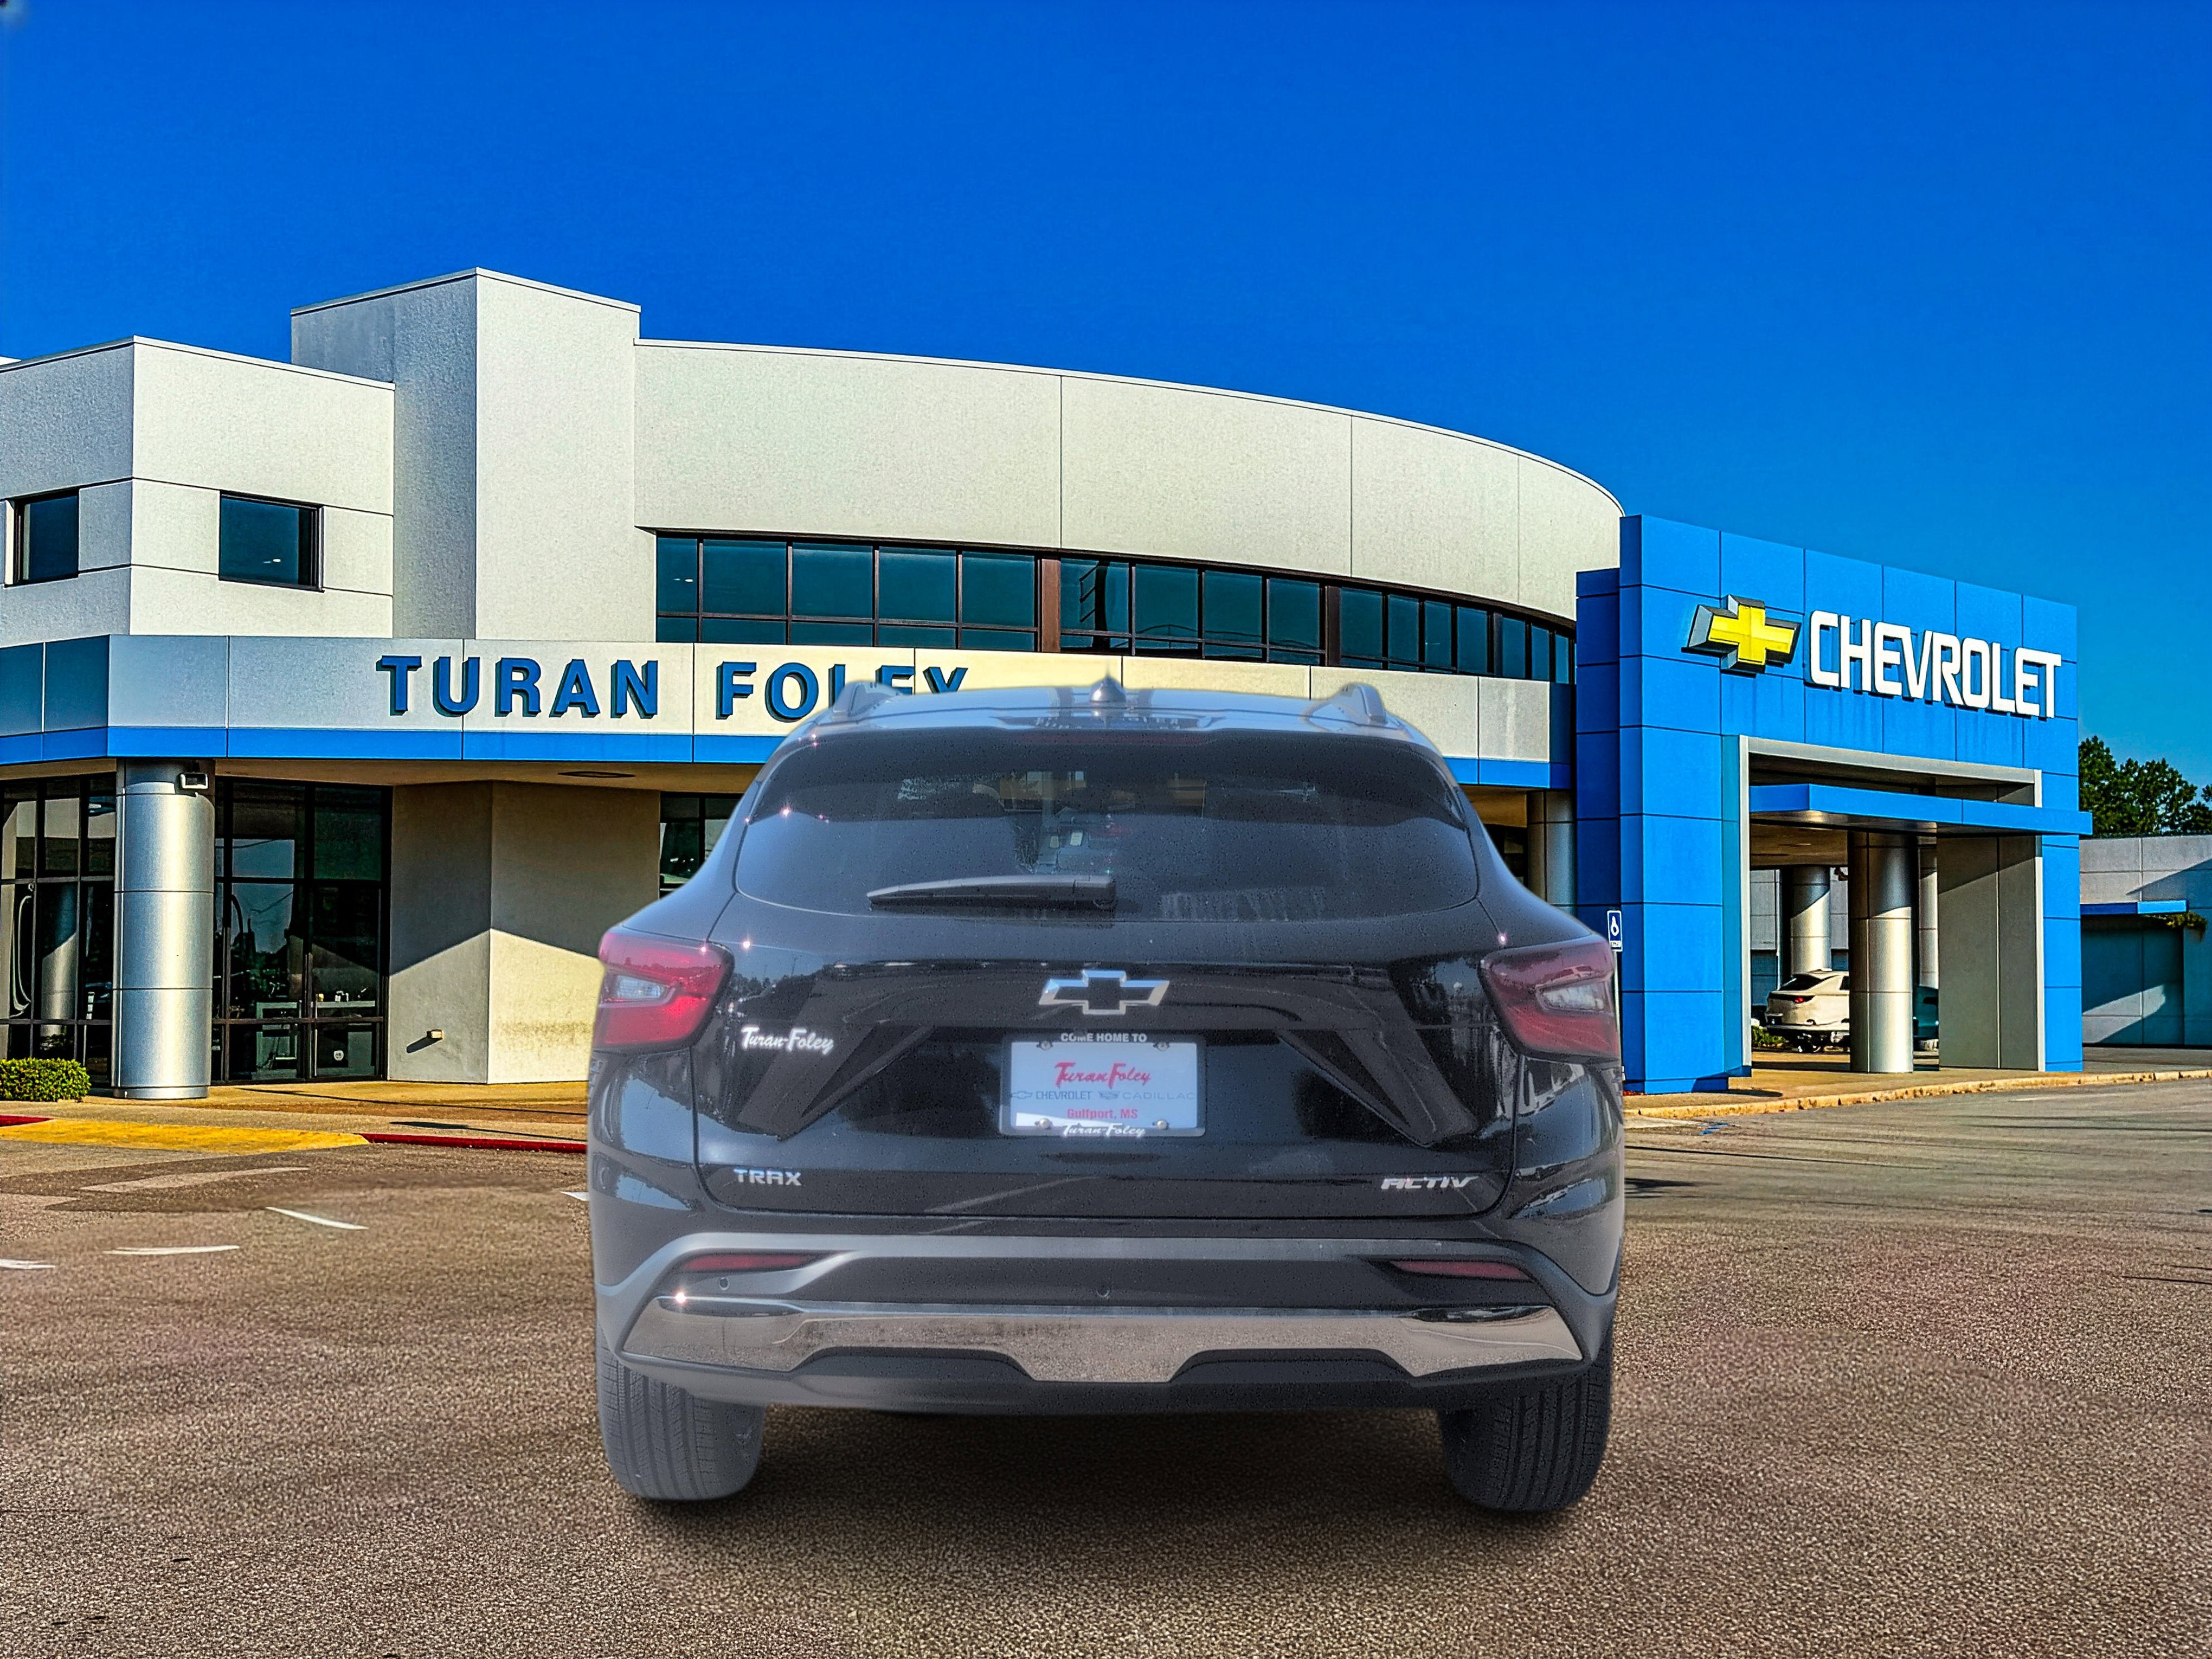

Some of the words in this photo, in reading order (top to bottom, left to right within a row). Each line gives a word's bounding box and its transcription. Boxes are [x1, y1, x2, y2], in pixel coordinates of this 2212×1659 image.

[1809, 610, 2062, 718] CHEVROLET
[376, 655, 658, 719] TURAN
[1096, 1033, 1129, 1042] HOME
[1131, 1033, 1148, 1042] TO
[1036, 1091, 1092, 1100] CHEVROLET
[1122, 1092, 1195, 1100] CADILLAC
[1067, 1109, 1117, 1120] Gulfport,
[1120, 1109, 1138, 1119] MS
[733, 1168, 802, 1186] TRAX
[1380, 1175, 1480, 1189] ACTIV
